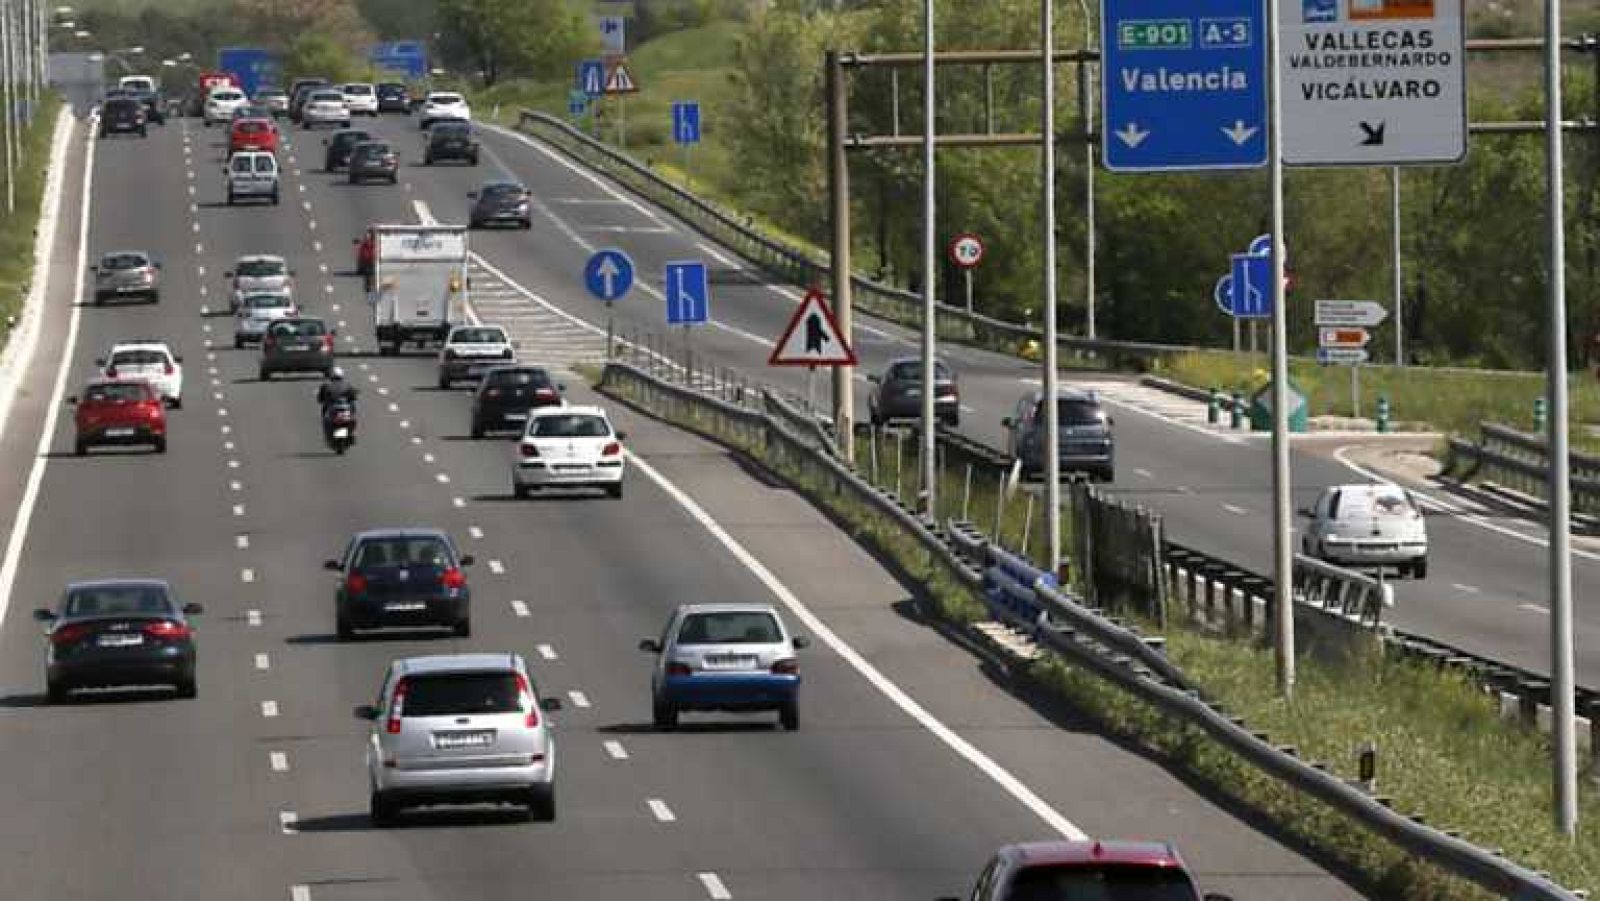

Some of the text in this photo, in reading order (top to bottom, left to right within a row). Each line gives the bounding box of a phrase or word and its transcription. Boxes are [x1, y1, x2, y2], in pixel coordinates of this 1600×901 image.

[1122, 25, 1187, 43] E-901
[1205, 22, 1247, 43] A-3
[1304, 29, 1434, 51] VALLECAS
[1290, 51, 1451, 69] VALDEBERNARDO
[1122, 66, 1248, 92] Valencia
[1301, 76, 1441, 100] VICÁLVARO
